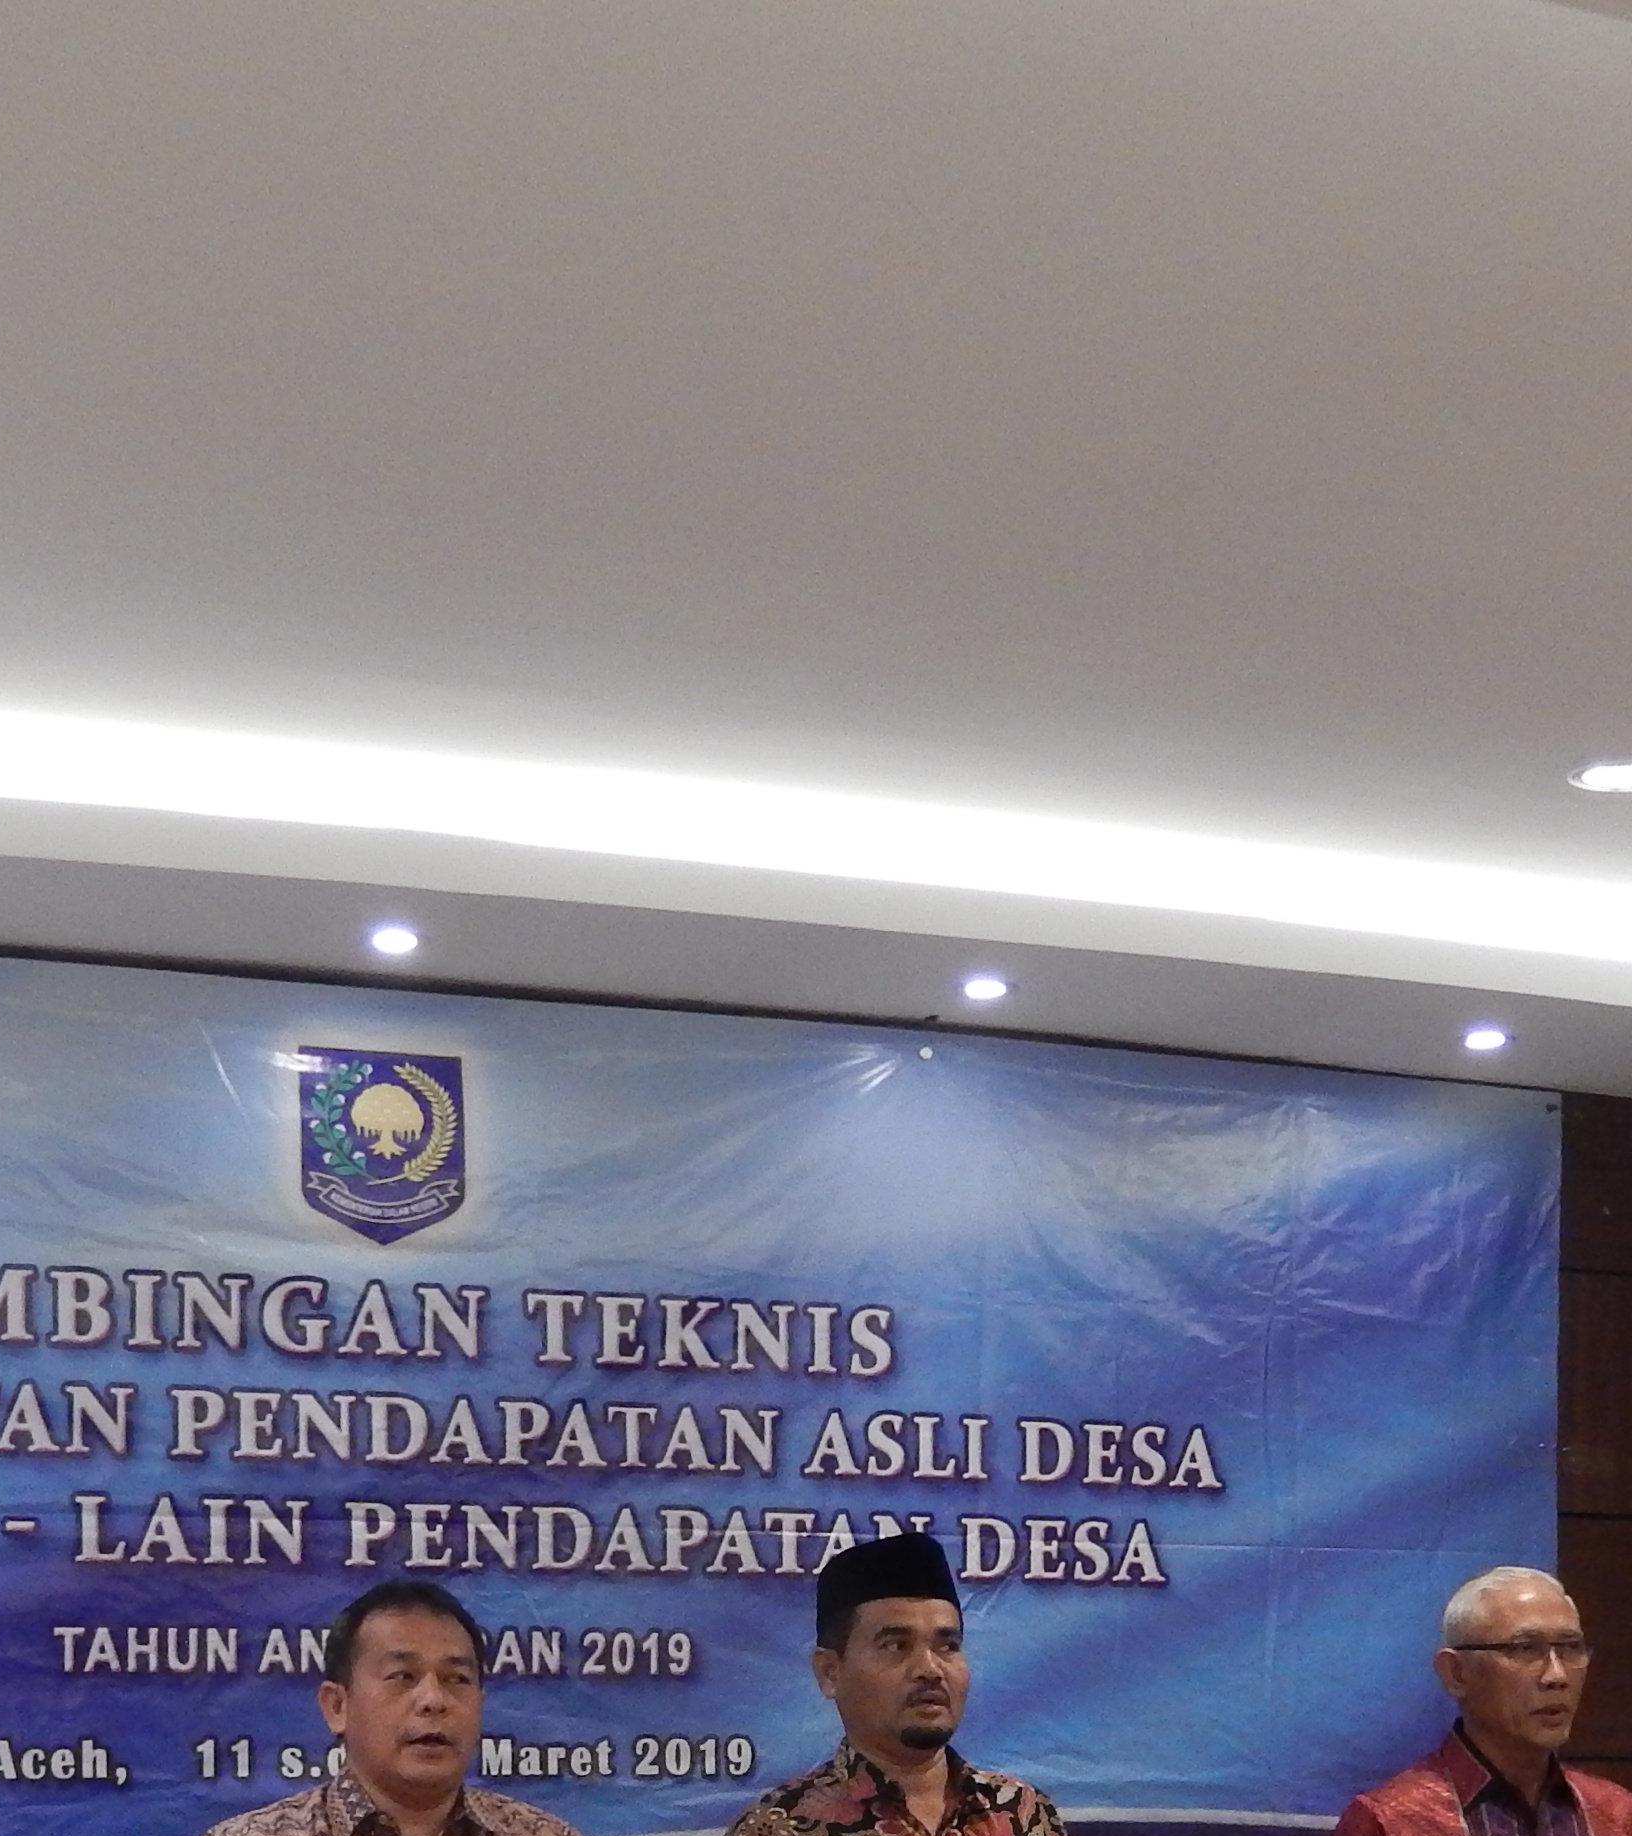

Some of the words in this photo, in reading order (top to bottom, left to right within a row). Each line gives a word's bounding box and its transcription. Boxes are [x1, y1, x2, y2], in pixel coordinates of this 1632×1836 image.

[525, 1291, 894, 1378] TEKNIS
[169, 1386, 780, 1474] PENDAPATAN
[802, 1409, 991, 1482] ASLI
[1018, 1418, 1225, 1491] DESA
[73, 1493, 310, 1567] LAIN
[958, 1515, 1168, 1584] DESA
[53, 1625, 238, 1674] TAHUN
[581, 1630, 692, 1677] 2019
[195, 1738, 251, 1779] 11
[480, 1737, 614, 1777] Maret
[634, 1737, 754, 1777] 2019
